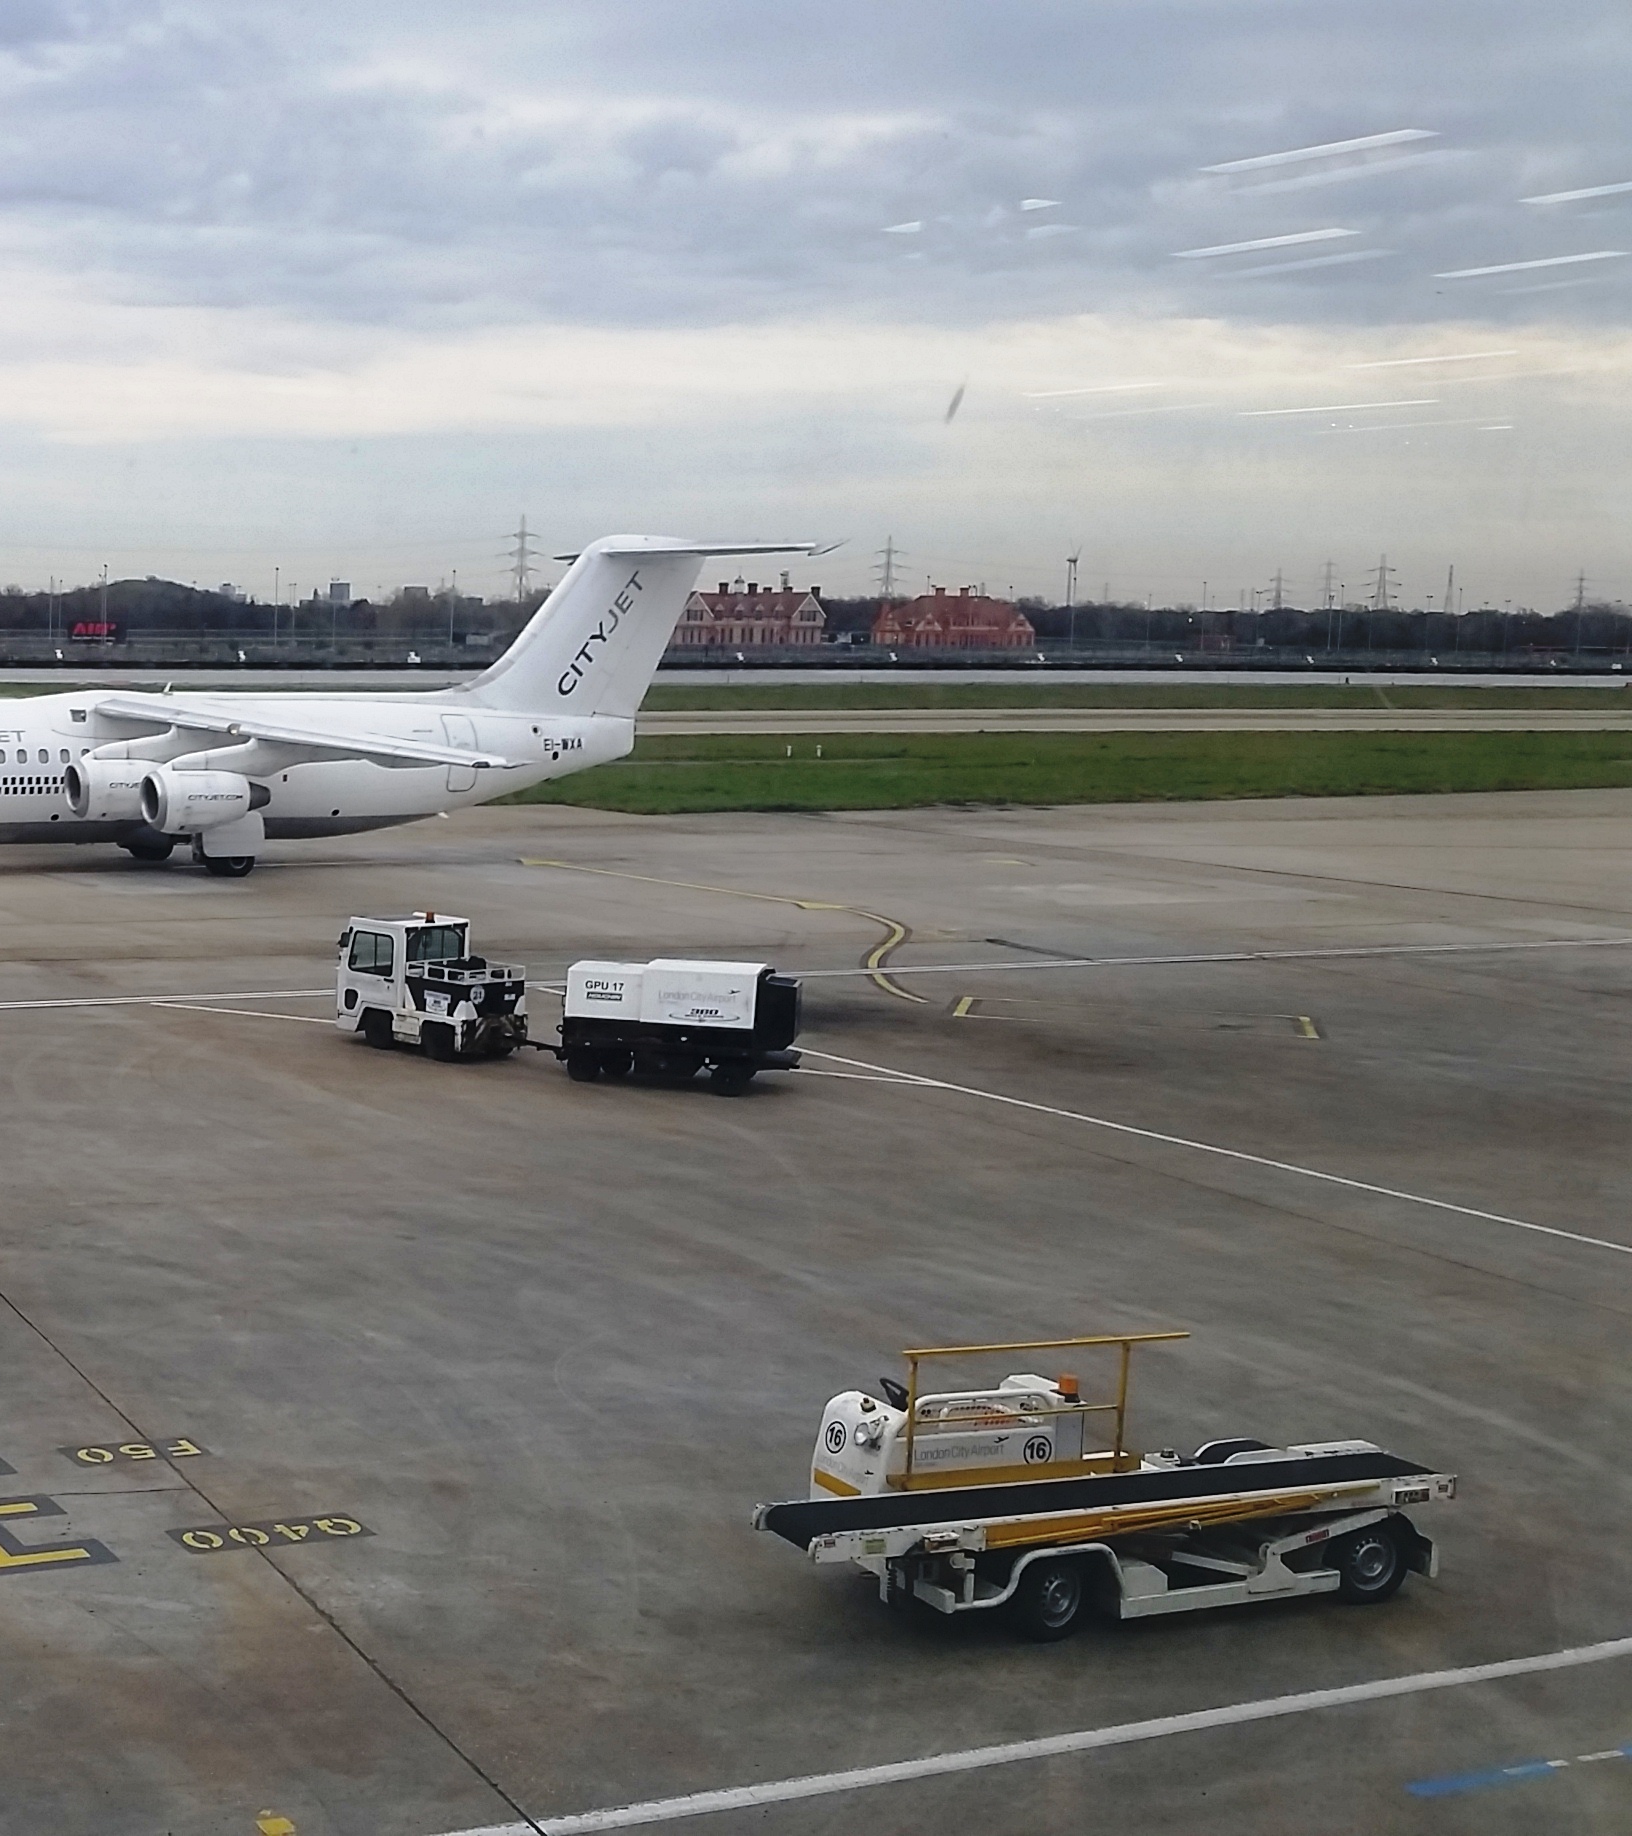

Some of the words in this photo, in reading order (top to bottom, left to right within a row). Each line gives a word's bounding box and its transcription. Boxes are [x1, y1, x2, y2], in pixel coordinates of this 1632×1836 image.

[558, 571, 644, 696] CITYJET
[543, 737, 583, 751] EI-WXA
[585, 980, 609, 991] GPU
[612, 982, 624, 992] 17
[658, 990, 689, 1001] London
[690, 992, 707, 1003] City
[707, 992, 737, 1005] Airport
[829, 1426, 843, 1446] 16
[77, 1438, 202, 1465] F50
[914, 1444, 950, 1461] London
[951, 1445, 972, 1461] City
[972, 1443, 1005, 1459] Airport
[1027, 1441, 1046, 1460] 16
[181, 1516, 364, 1551] Q400
